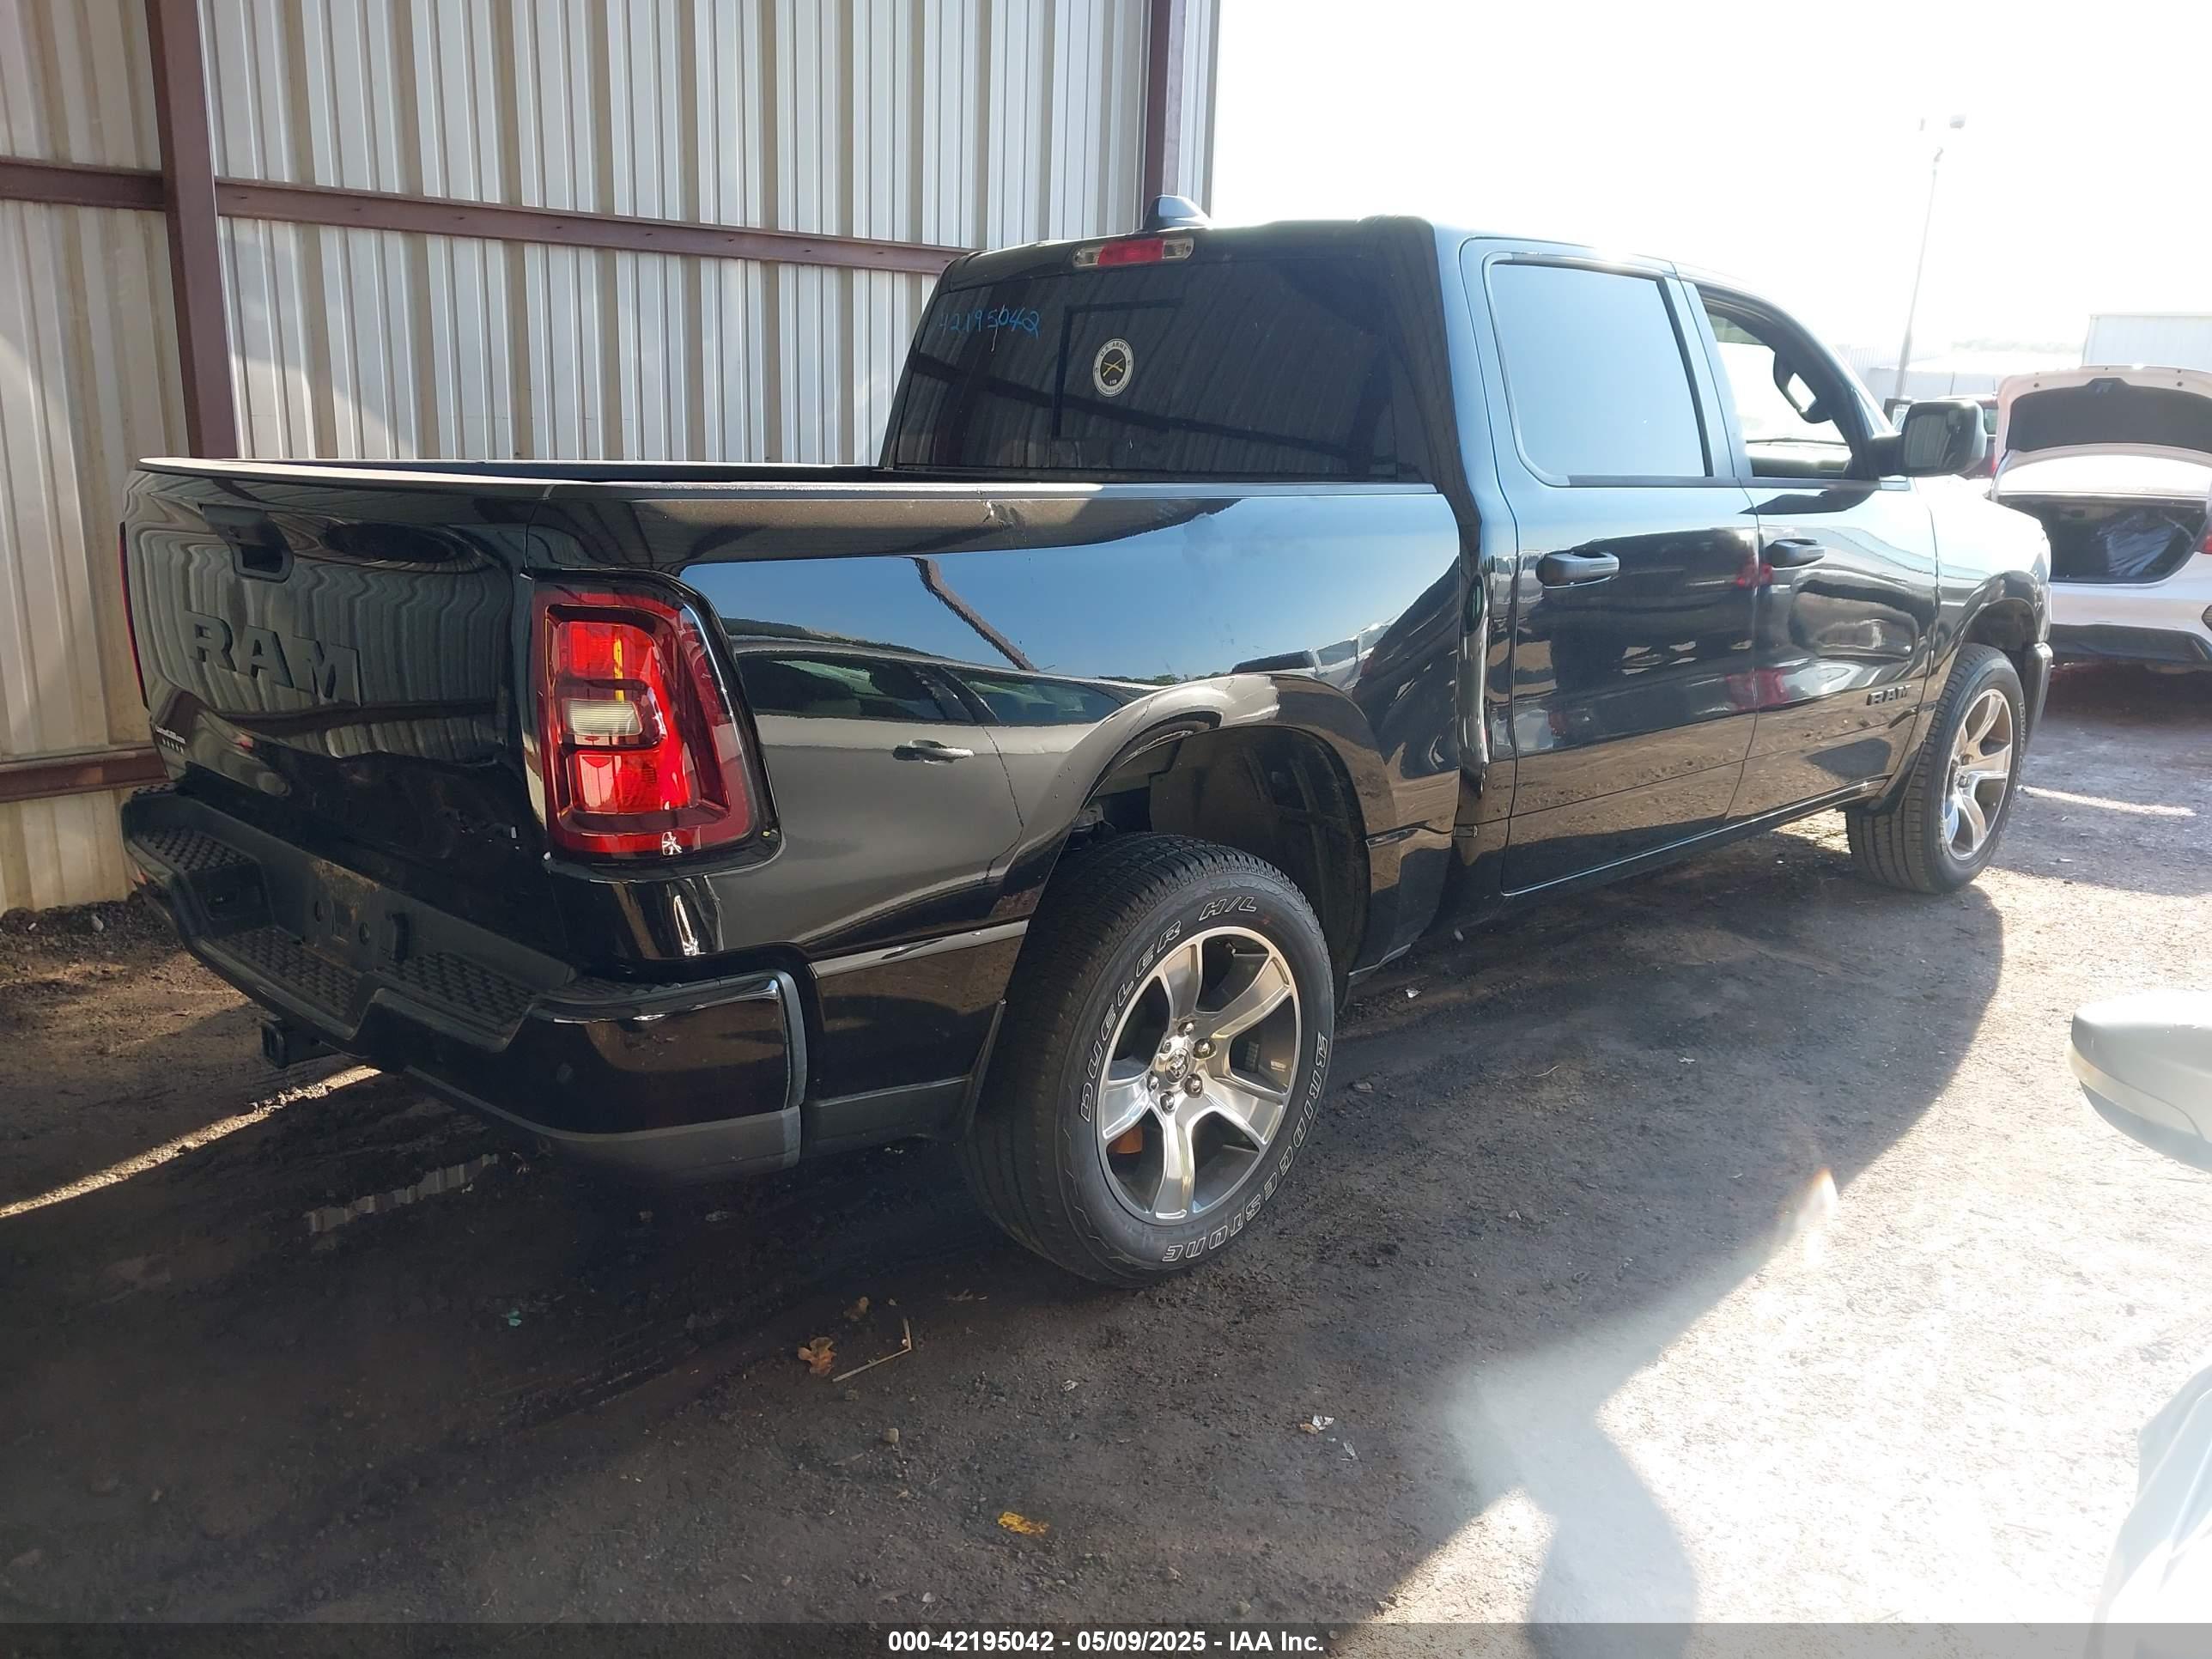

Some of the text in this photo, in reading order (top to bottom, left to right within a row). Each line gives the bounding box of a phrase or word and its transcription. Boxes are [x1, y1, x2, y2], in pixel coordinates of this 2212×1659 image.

[939, 304, 1040, 340] 42195042
[1111, 342, 1127, 352] ARMY
[185, 610, 363, 707] RAM
[1866, 685, 1911, 706] RAM
[1080, 896, 1257, 1122] DUELER H/L
[1161, 1030, 1328, 1262] BRIDGESTONE
